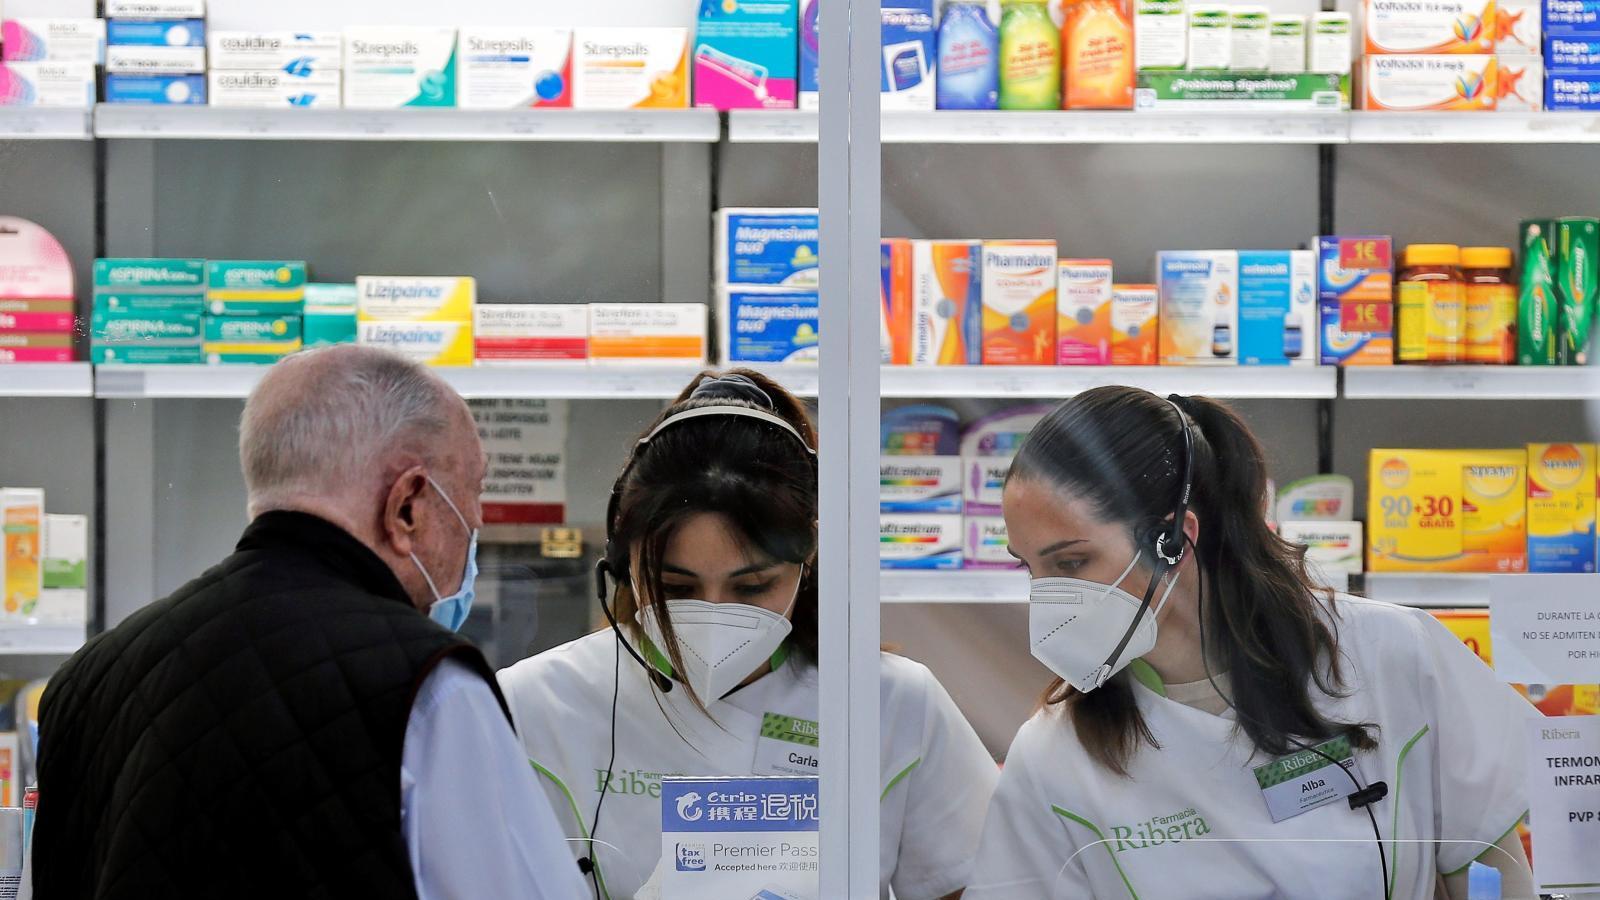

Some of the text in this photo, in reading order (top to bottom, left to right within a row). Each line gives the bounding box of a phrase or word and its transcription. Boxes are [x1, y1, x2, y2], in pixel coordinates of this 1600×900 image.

[352, 39, 419, 57] Strepsils
[467, 36, 534, 54] Strepsils
[583, 41, 649, 58] Strepsils
[987, 253, 1053, 267] Pharmaton
[365, 282, 442, 302] Lizipaina
[366, 327, 443, 346] Lizipaina
[1537, 612, 1595, 620] DURANTE LA
[1523, 631, 1595, 640] NO SE ADMITEN
[1568, 650, 1600, 659] POR HI
[1541, 729, 1581, 740] Ribera
[788, 752, 818, 768] Carla
[593, 768, 662, 798] Ribe
[1301, 779, 1326, 794] Alba
[707, 791, 758, 803] Ctrip
[708, 806, 758, 821] 携程
[761, 793, 818, 820] 退税
[1151, 807, 1197, 825] Farmacia
[1569, 811, 1594, 822] PVP
[1110, 817, 1211, 852] Ribera
[682, 847, 700, 857] tax
[713, 843, 817, 857] Premier Pass
[682, 856, 704, 866] free
[714, 863, 777, 872] Accepted here
[779, 862, 818, 872] 欢迎使用
